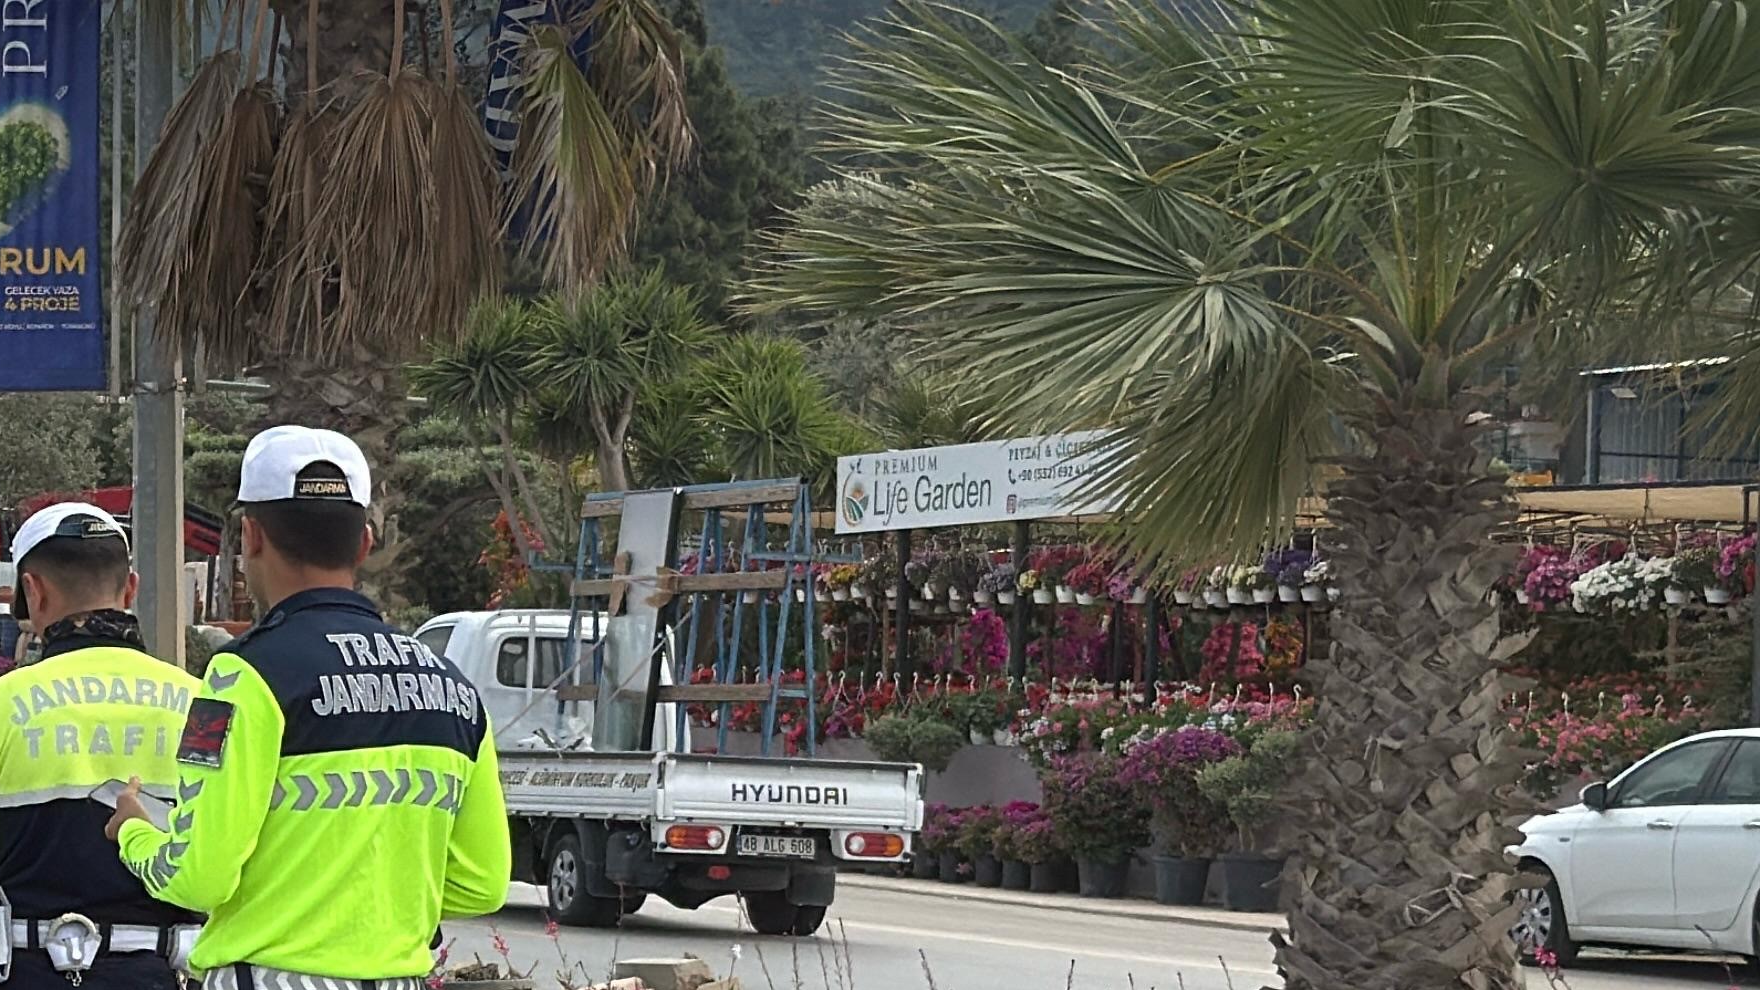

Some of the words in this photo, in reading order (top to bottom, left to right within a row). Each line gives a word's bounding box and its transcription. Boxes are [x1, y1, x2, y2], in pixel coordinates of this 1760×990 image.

[4, 286, 49, 296] GELECEK
[52, 286, 80, 296] YAZA
[4, 298, 18, 312] 4
[20, 298, 81, 312] PROJE
[874, 455, 938, 475] PREMIUM
[873, 479, 908, 526] Life
[914, 472, 991, 513] Garden
[326, 632, 446, 670] TRAFİK
[10, 676, 188, 725] JANDARM
[311, 673, 478, 725] JANDARMASI
[23, 724, 182, 759] TRAFİ
[731, 783, 848, 806] HYUNDAI
